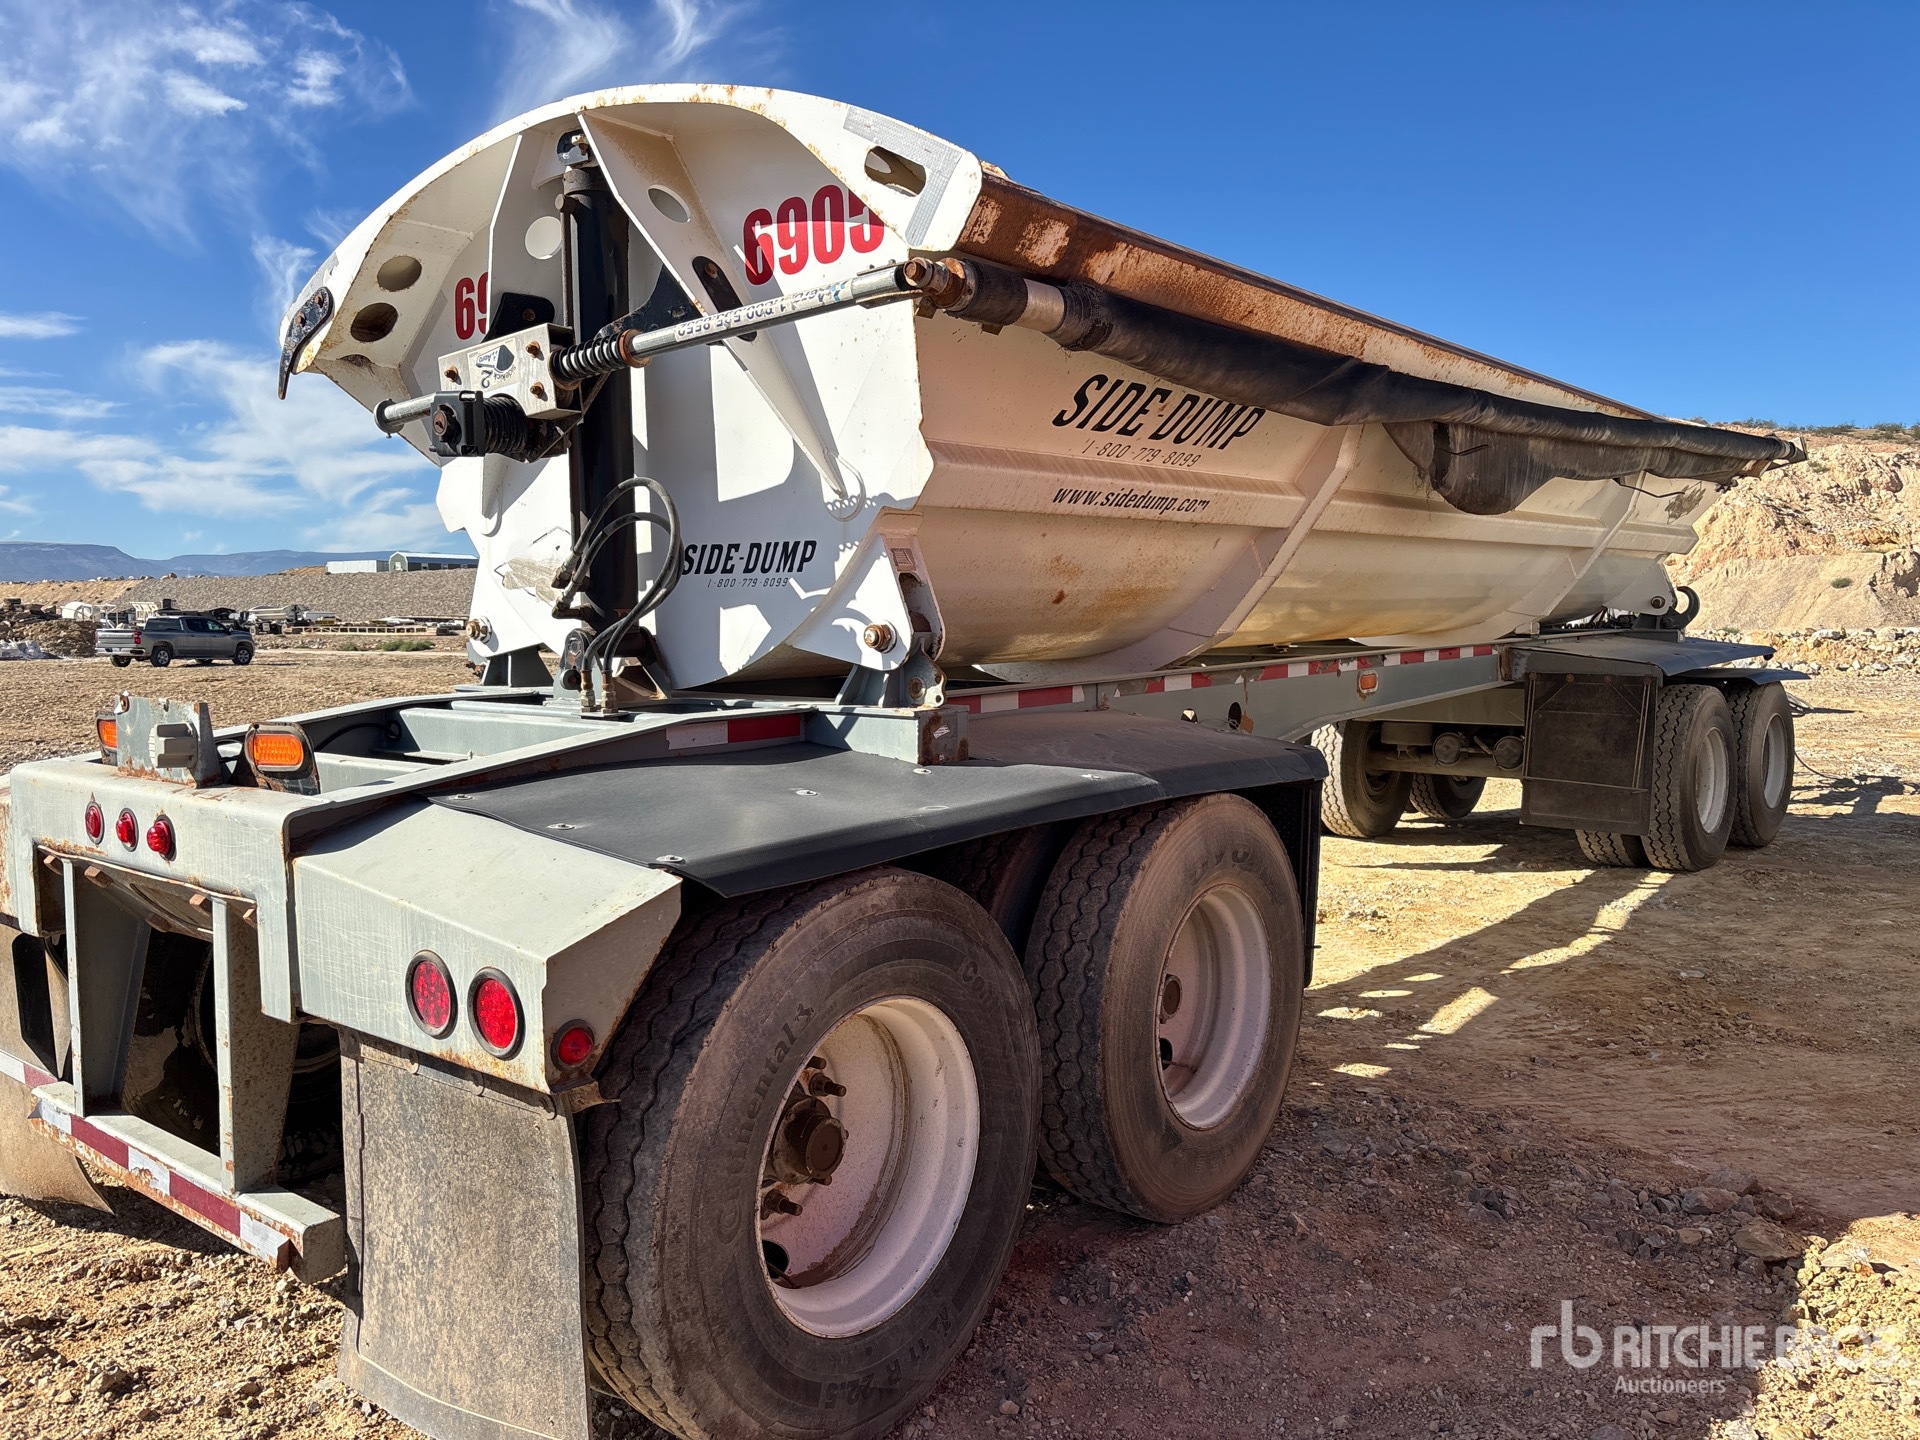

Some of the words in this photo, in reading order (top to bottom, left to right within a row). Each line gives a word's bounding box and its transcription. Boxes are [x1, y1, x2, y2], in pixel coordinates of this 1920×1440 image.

[743, 184, 885, 286] 6905
[1052, 373, 1266, 451] SIDE-DUMP
[1051, 487, 1211, 515] www.sidedump.com
[682, 540, 818, 576] SIDE-DUMP
